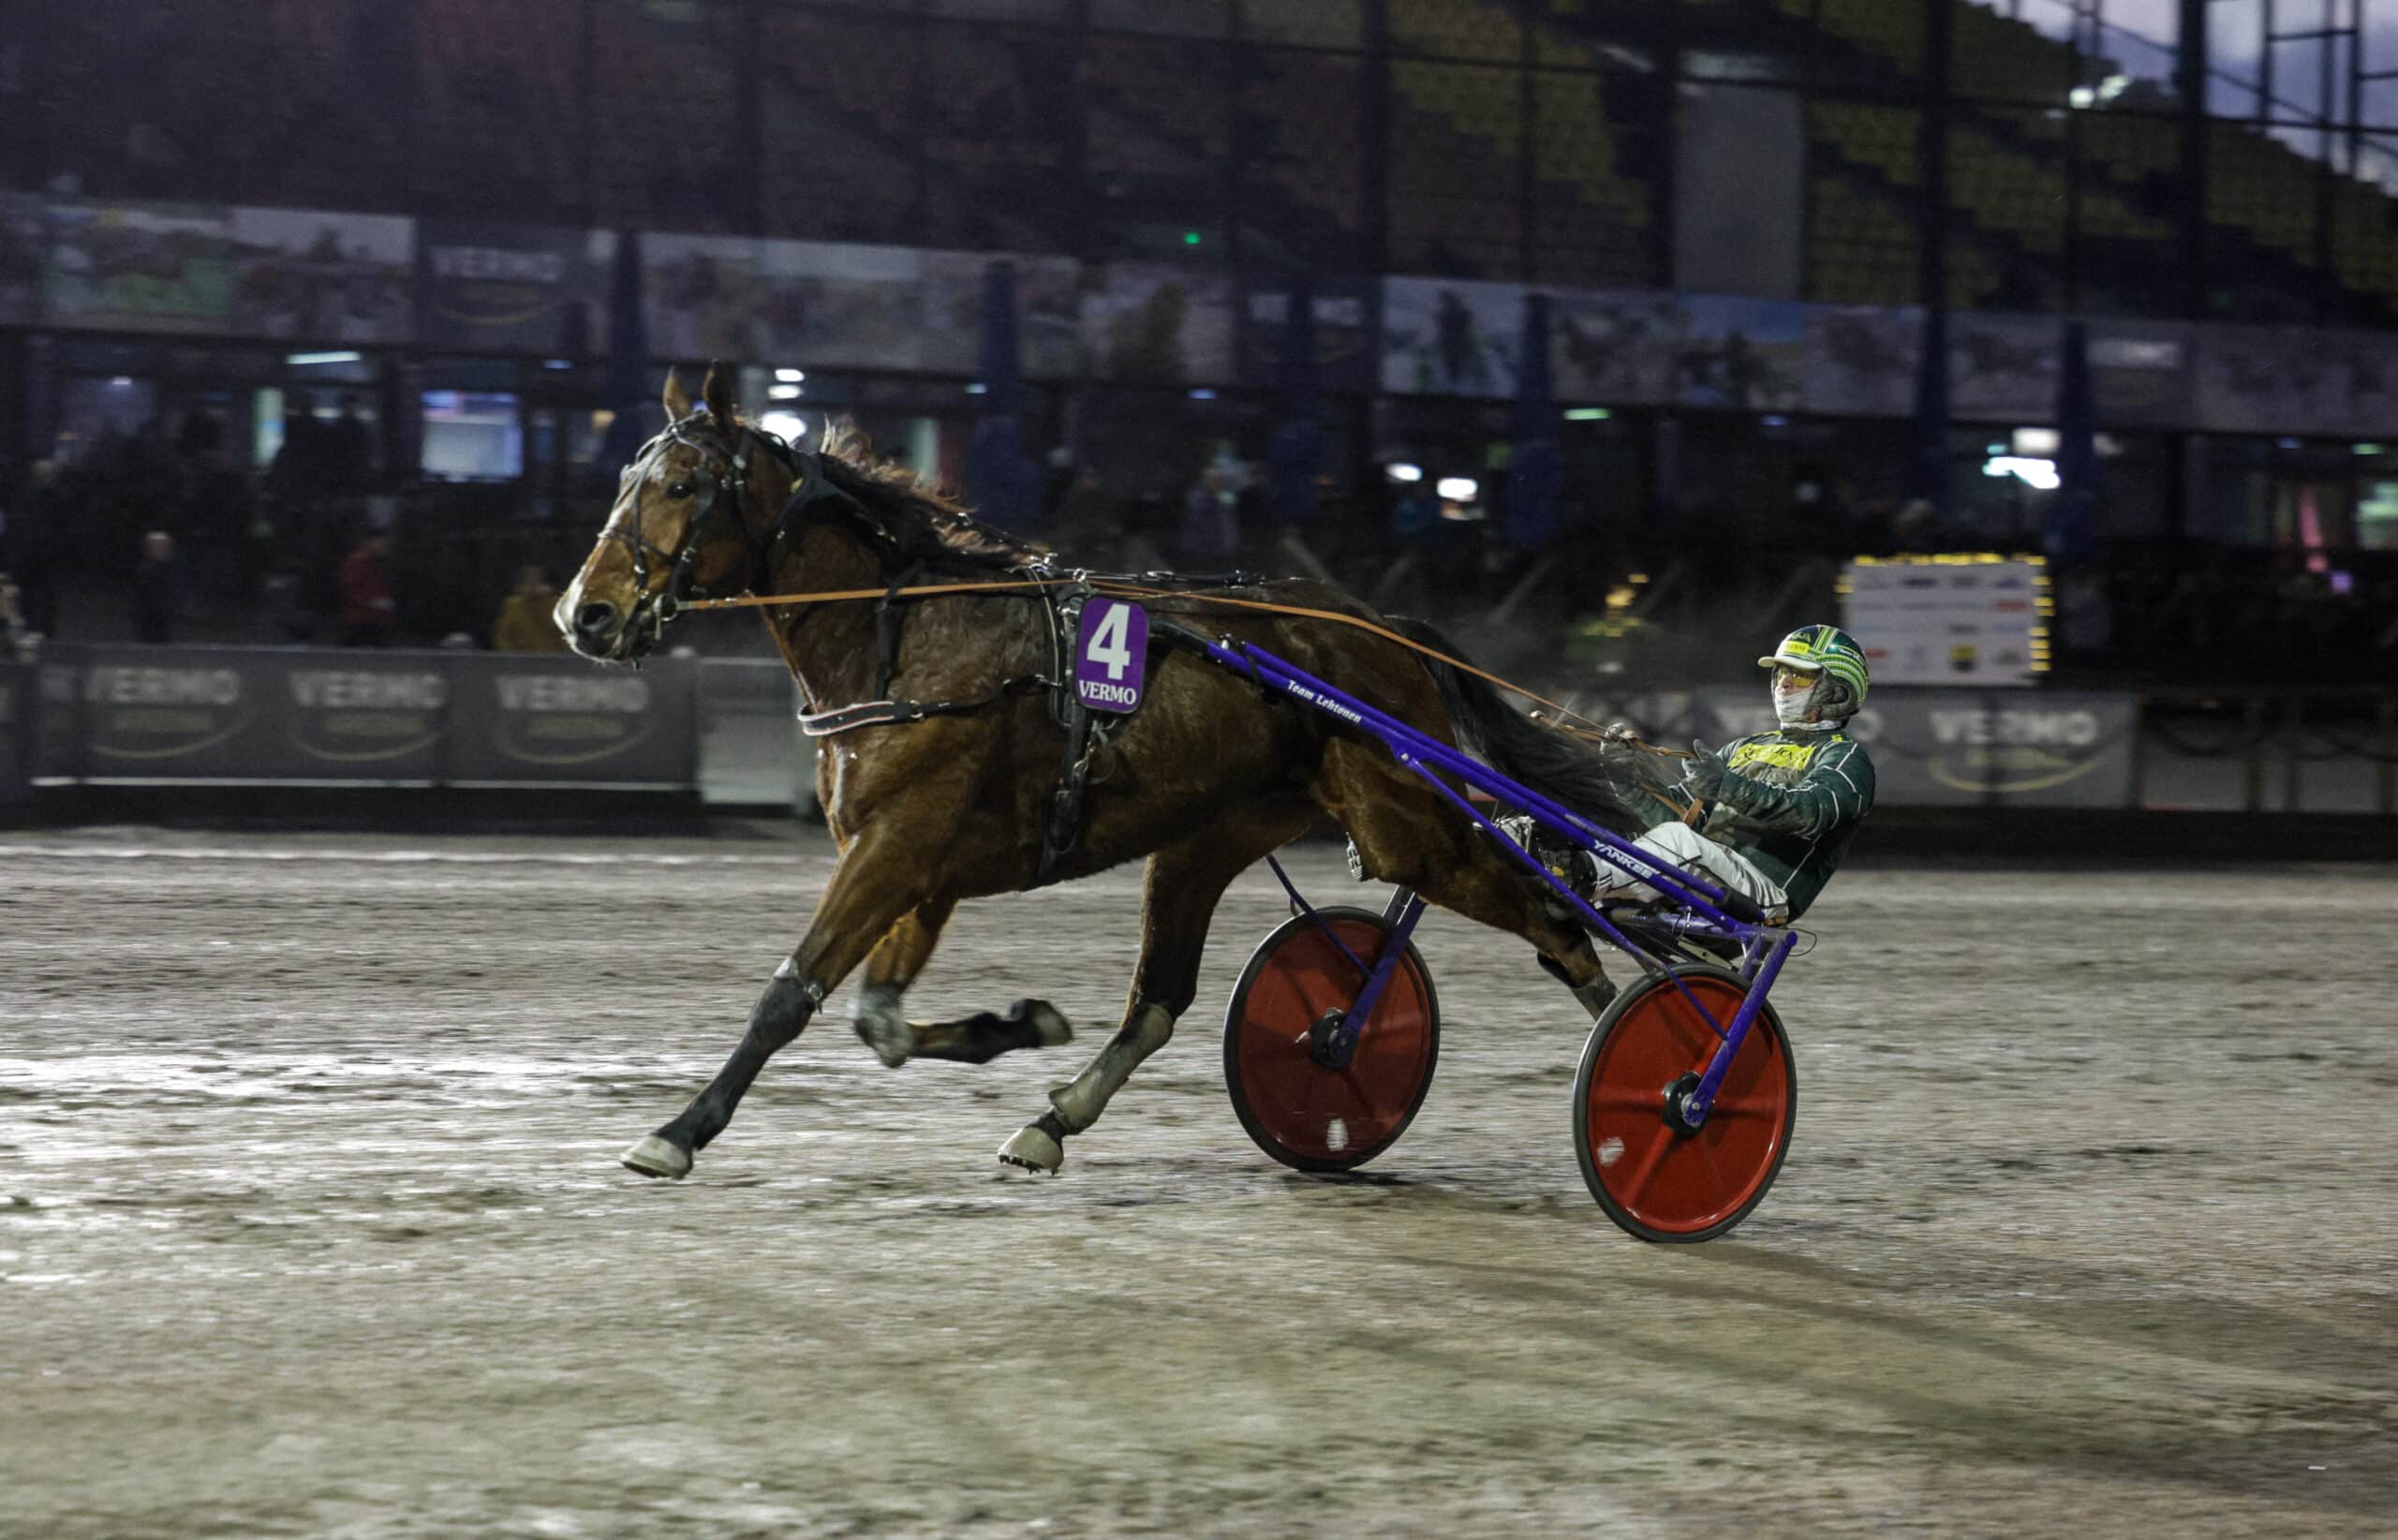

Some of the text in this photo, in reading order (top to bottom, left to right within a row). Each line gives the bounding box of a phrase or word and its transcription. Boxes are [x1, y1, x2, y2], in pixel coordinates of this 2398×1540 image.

[1087, 602, 1131, 680] 4
[288, 670, 448, 709] VERMO
[496, 675, 648, 712] VERMO
[1078, 679, 1137, 704] VERMO
[1288, 679, 1362, 724] Team Lehtonen
[1929, 709, 2098, 746] VERMO
[1593, 838, 1654, 880] YANKEE
